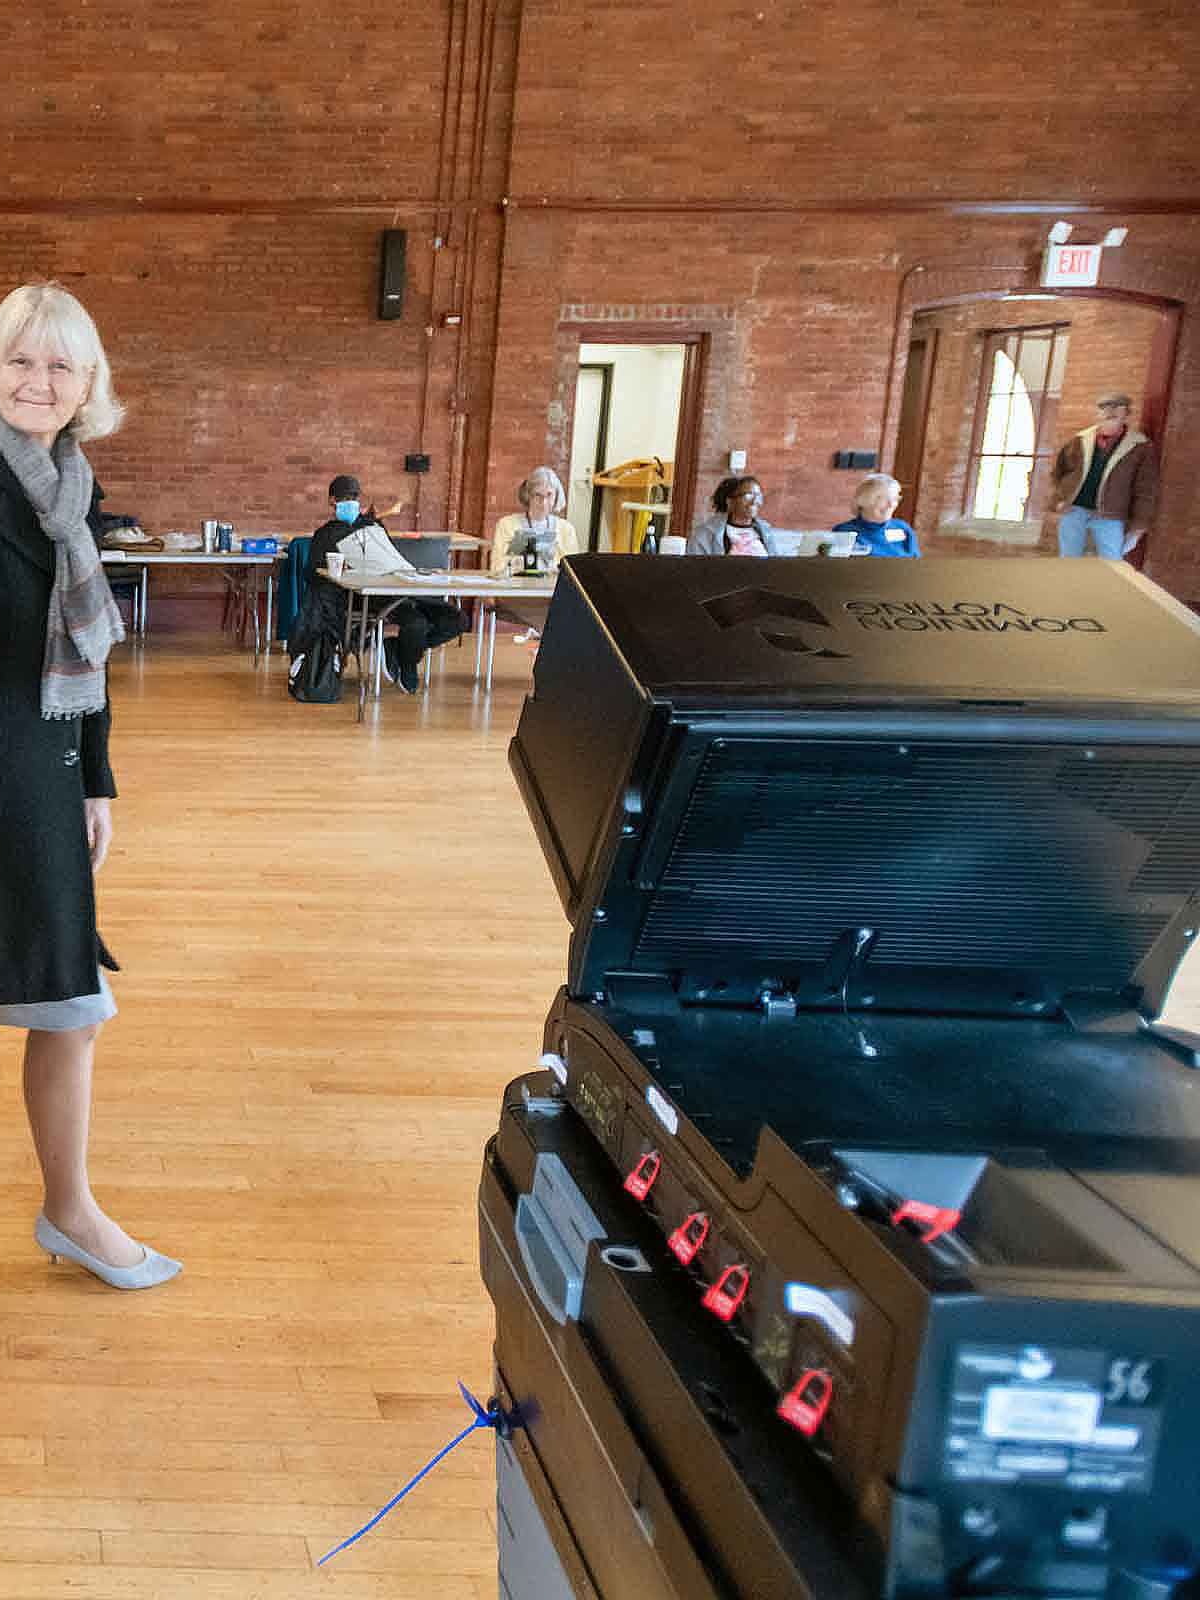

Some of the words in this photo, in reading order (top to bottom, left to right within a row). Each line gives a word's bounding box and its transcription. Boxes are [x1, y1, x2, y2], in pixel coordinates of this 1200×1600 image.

[1057, 249, 1092, 274] EXIT
[845, 602, 1027, 616] VOTING
[856, 616, 1107, 633] DOMINION
[1104, 1360, 1152, 1402] 56
